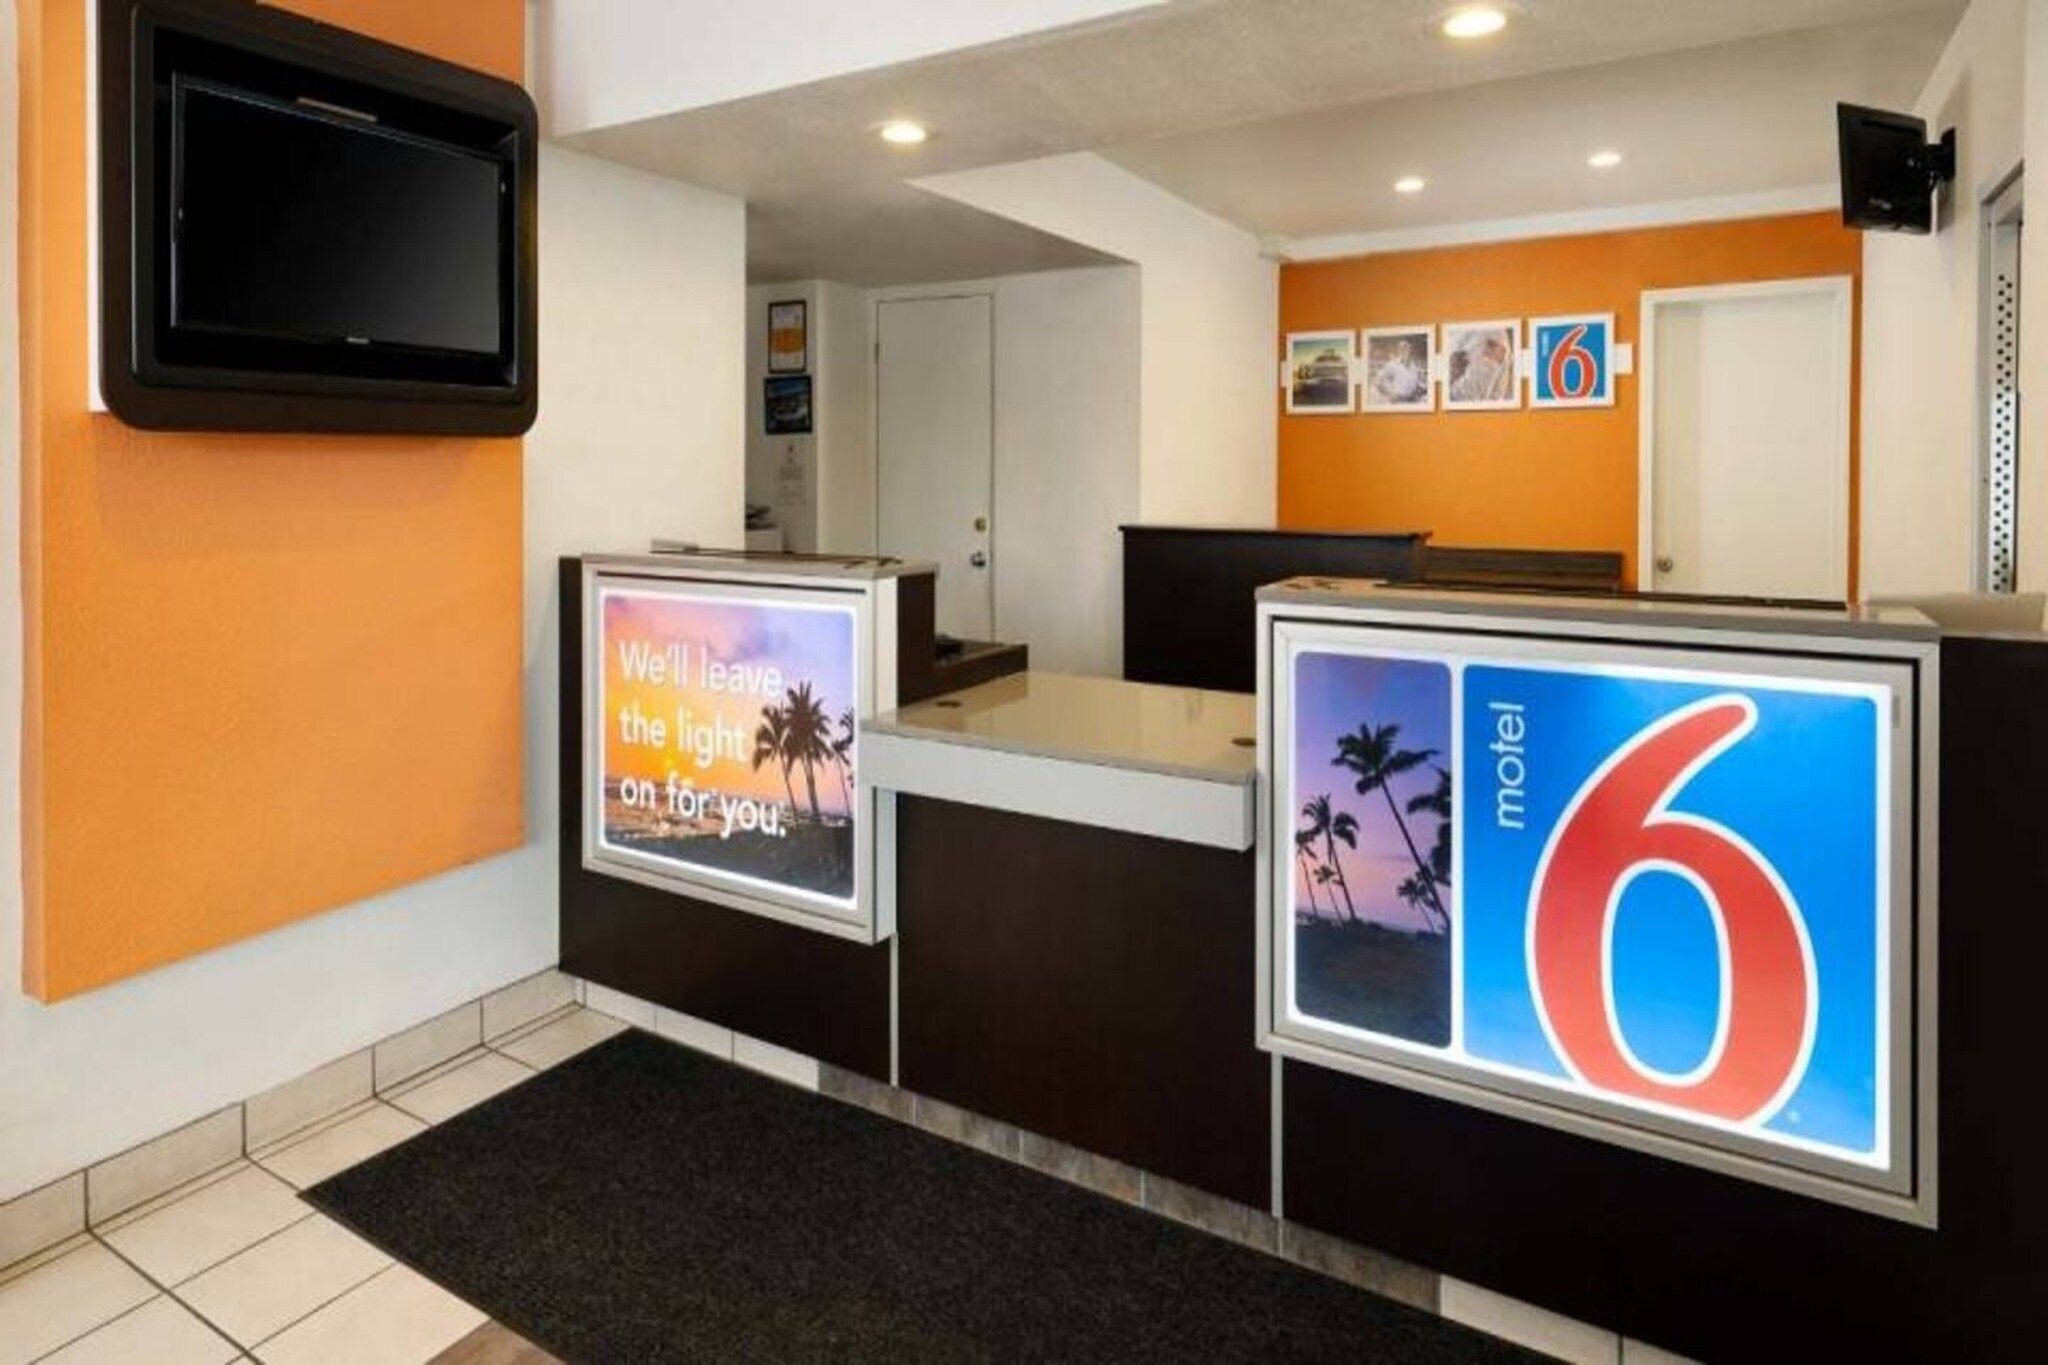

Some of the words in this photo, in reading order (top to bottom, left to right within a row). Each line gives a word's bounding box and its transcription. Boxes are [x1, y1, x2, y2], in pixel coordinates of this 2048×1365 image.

[1548, 323, 1597, 399] 6
[619, 640, 688, 685] We'll
[700, 647, 784, 697] leave
[618, 702, 667, 747] the
[677, 707, 751, 768] light
[619, 776, 656, 810] on
[665, 770, 712, 821] for
[719, 797, 786, 838] you.
[1489, 702, 1524, 830] motel
[1525, 693, 1819, 1128] 6
